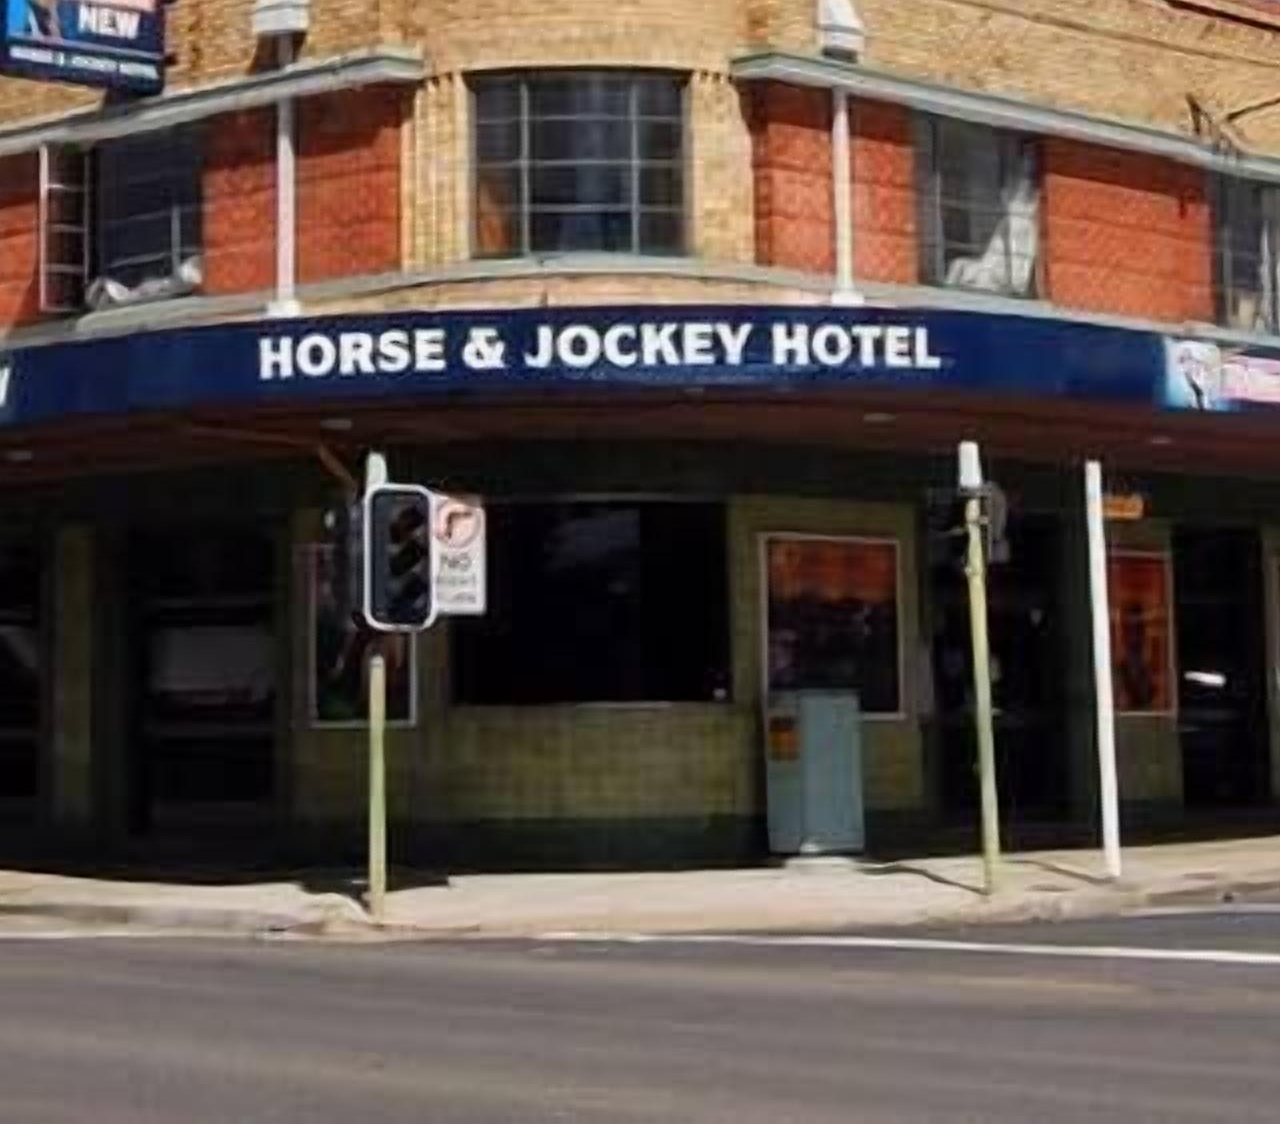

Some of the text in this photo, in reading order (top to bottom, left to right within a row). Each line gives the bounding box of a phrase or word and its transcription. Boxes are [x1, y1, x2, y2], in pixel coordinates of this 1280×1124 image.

[78, 3, 141, 40] NEW
[258, 322, 942, 378] HORSE & JOCKEY HOTEL
